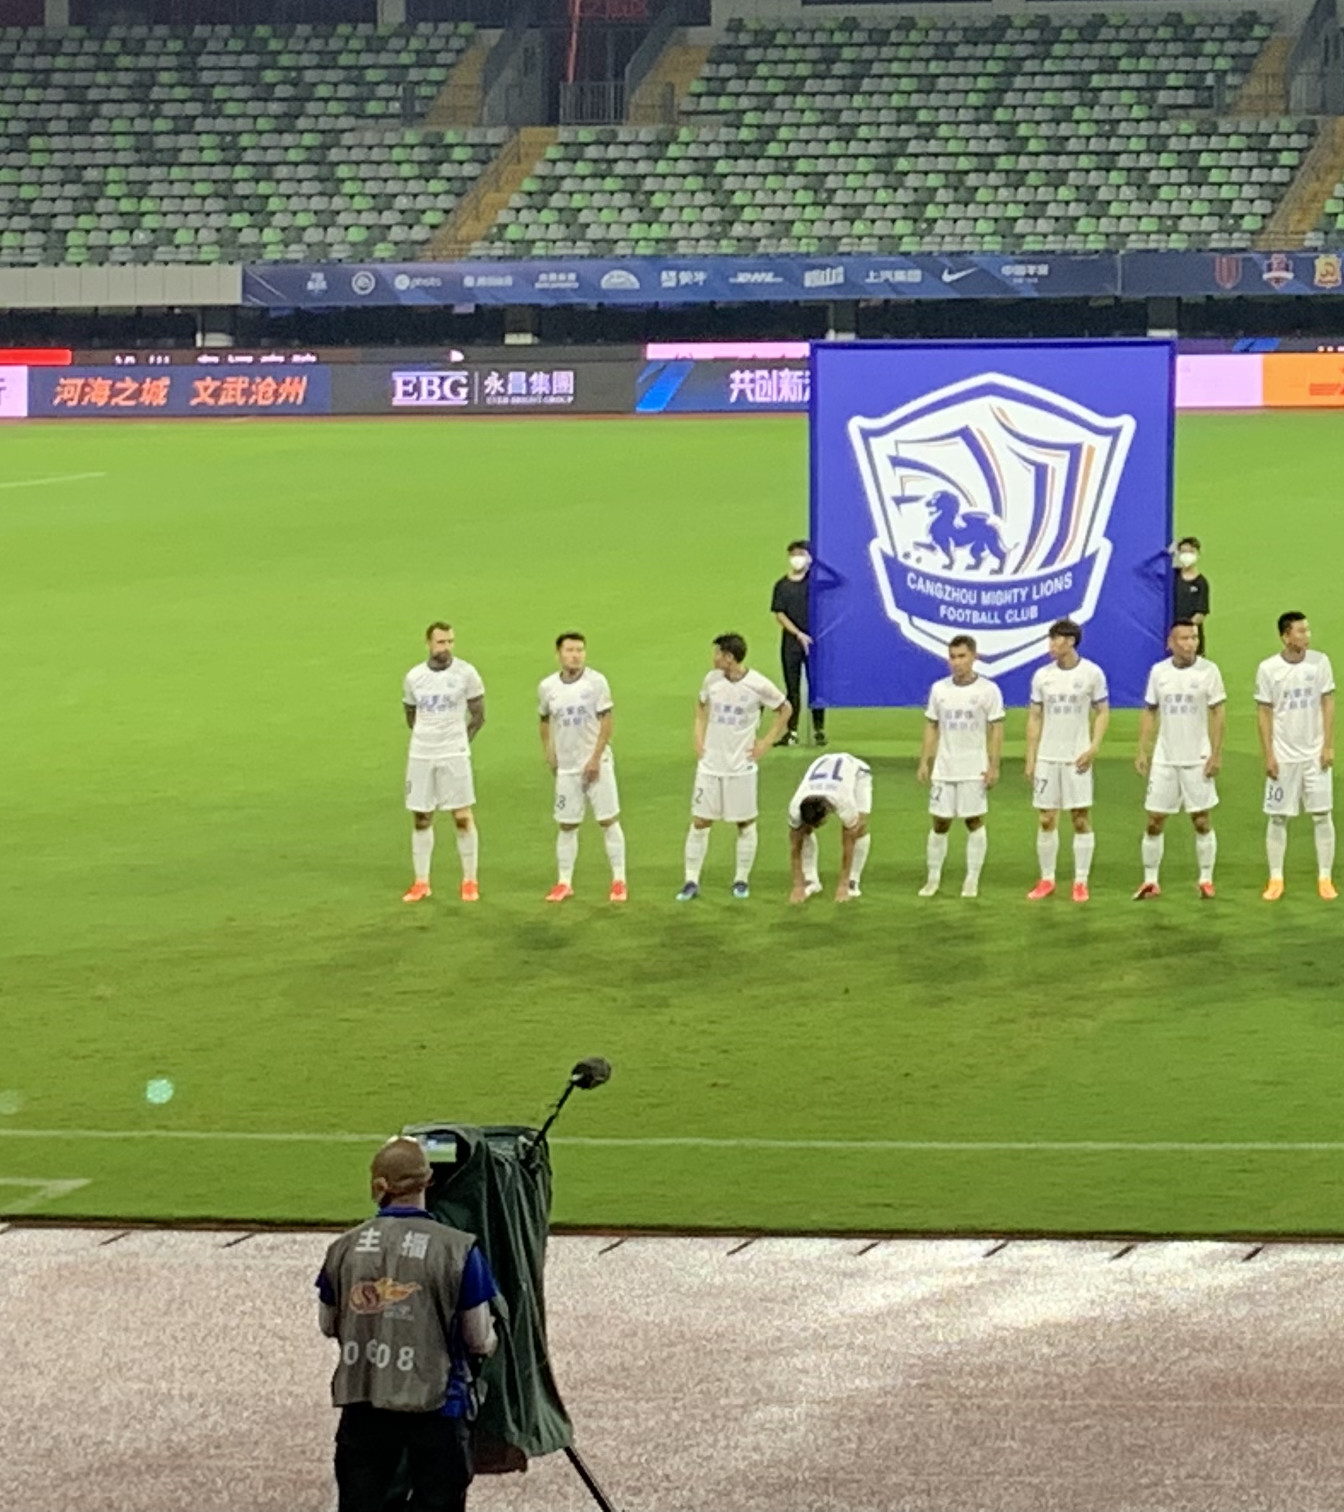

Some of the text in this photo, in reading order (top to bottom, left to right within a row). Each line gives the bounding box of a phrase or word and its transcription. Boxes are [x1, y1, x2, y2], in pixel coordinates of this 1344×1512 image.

[54, 375, 309, 407] 河海之城 文武沧州
[393, 374, 469, 403] EBG
[907, 571, 1073, 606] CANGZHOU MIGHTY LIONS
[939, 604, 1039, 624] FOOTBALL CLUB
